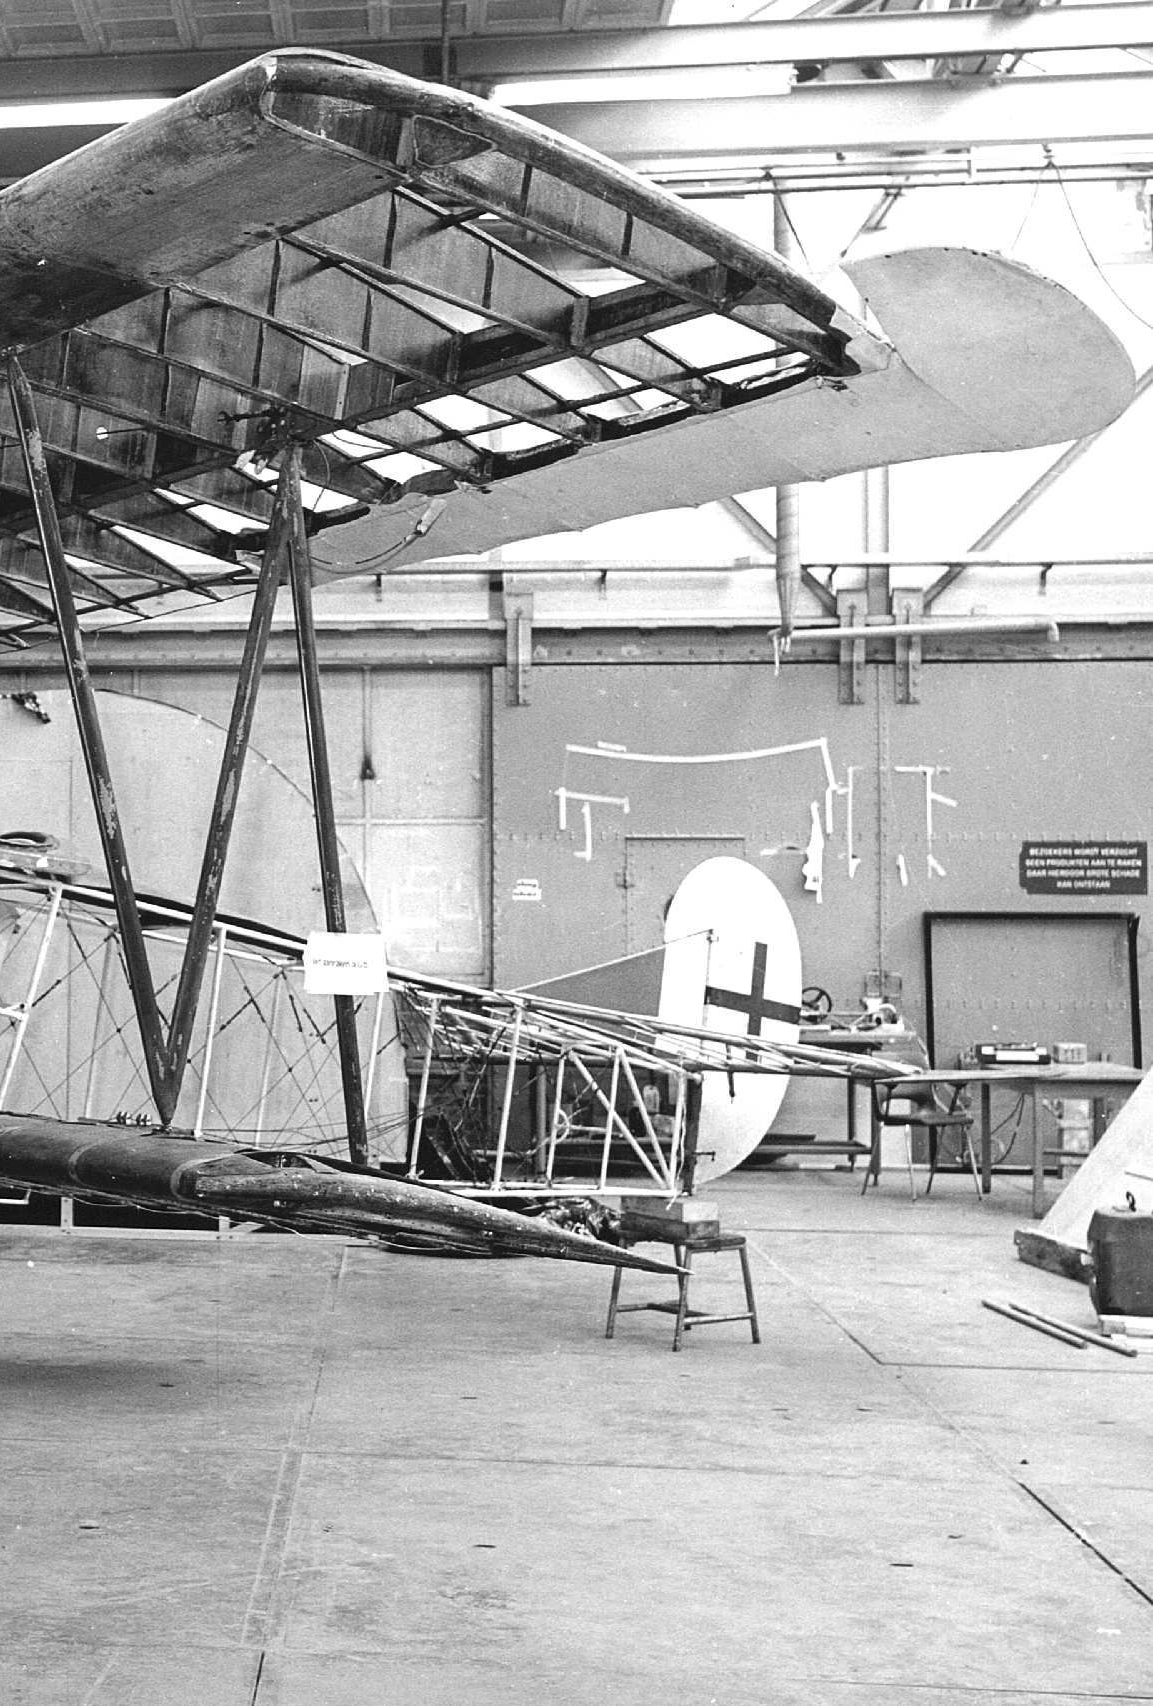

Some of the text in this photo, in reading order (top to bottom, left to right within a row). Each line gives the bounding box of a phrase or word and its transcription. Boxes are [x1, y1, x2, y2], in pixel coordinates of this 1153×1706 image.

[1029, 847, 1072, 856] BEZOEKERS
[1090, 858, 1106, 867] AAN
[1116, 858, 1142, 867] RAKEN
